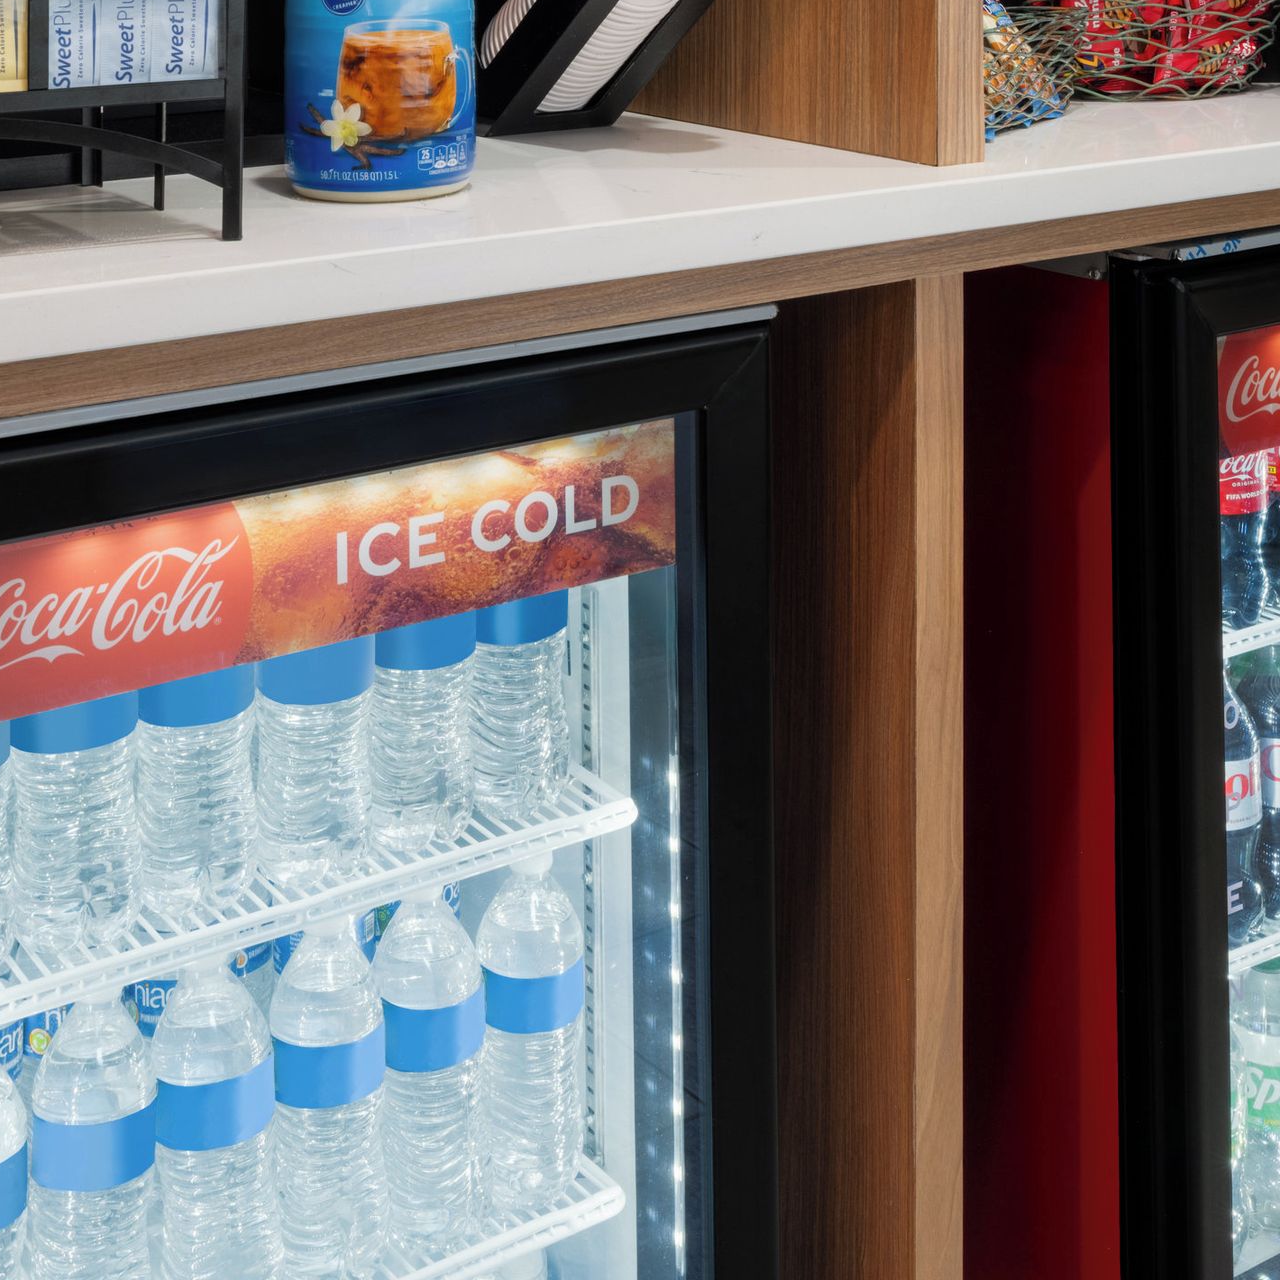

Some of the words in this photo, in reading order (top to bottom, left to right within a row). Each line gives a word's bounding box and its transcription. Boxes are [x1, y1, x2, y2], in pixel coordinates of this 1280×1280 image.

[342, 172, 352, 181] OZ
[1225, 493, 1241, 501] FIFA
[1241, 491, 1260, 500] WORLD
[335, 511, 446, 587] ICE
[470, 473, 641, 555] COLD
